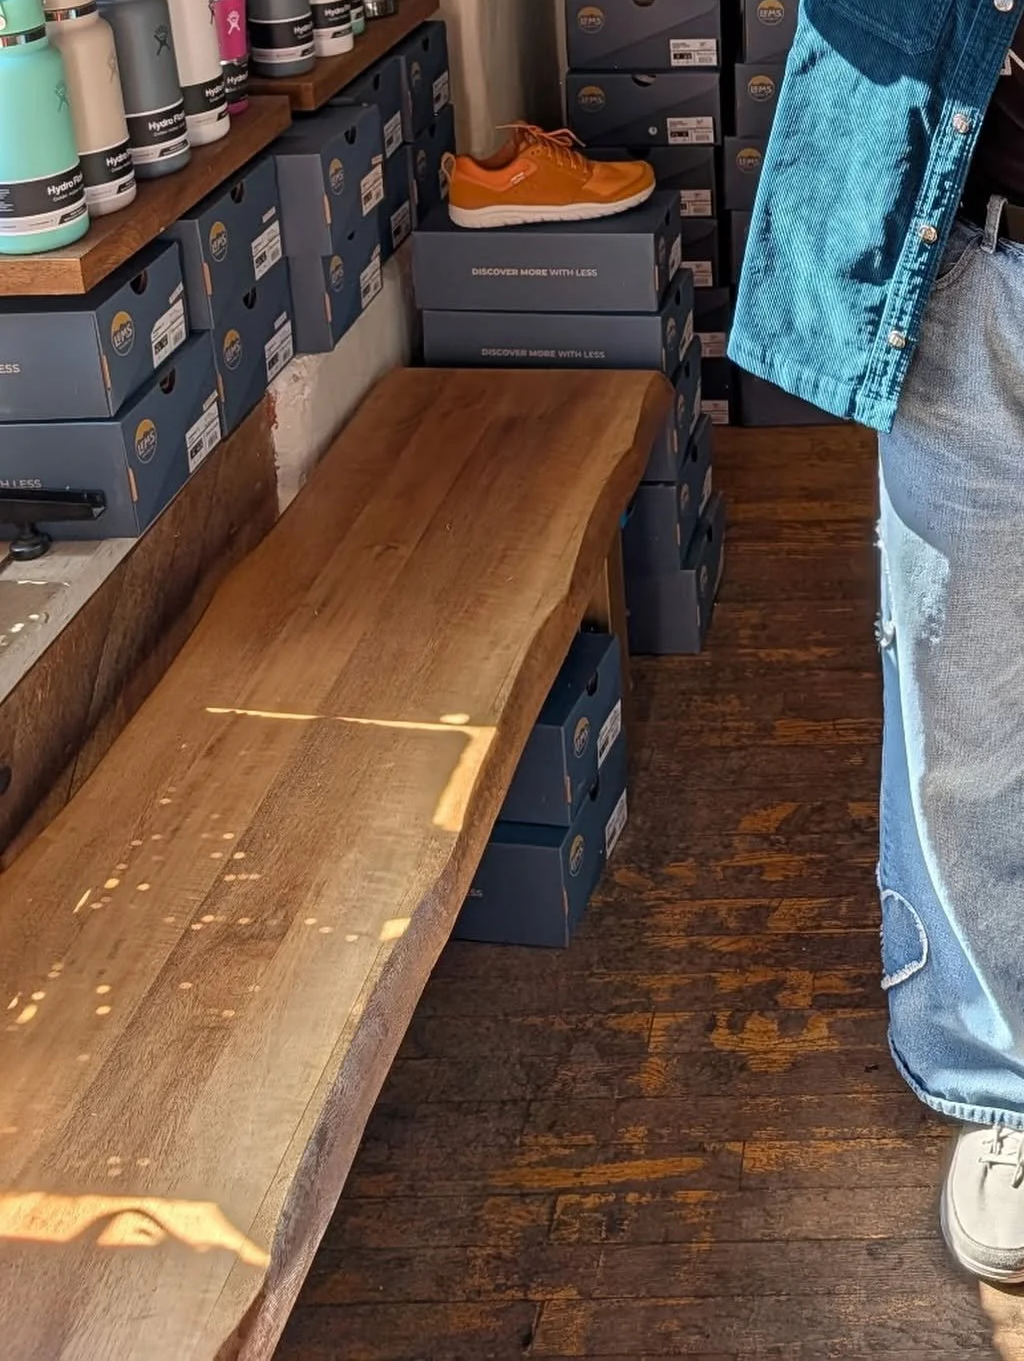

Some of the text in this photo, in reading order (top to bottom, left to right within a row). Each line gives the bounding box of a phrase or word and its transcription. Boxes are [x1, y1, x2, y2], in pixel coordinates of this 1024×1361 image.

[47, 181, 73, 195] Hydro
[472, 268, 518, 276] DISCOVER
[520, 268, 547, 276] MORE
[575, 269, 598, 277] LESS
[0, 364, 20, 373] ESS
